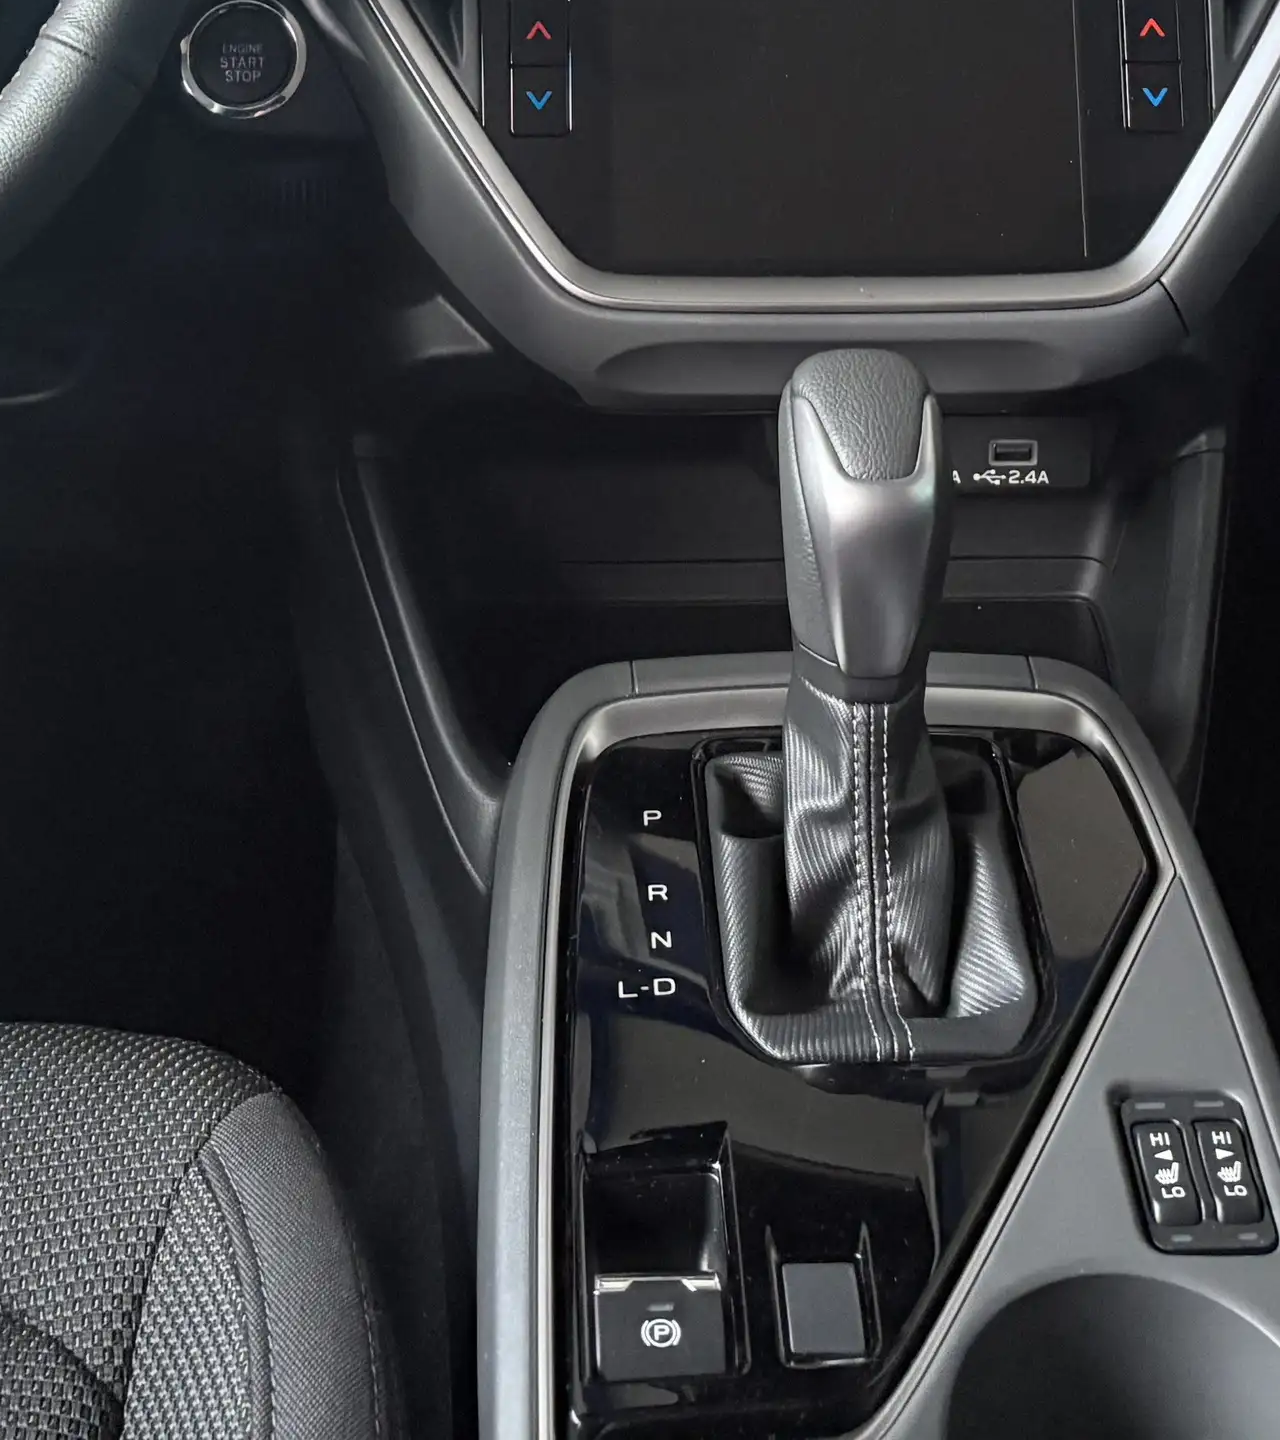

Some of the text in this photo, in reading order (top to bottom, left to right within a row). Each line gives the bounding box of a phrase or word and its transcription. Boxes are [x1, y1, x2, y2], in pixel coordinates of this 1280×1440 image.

[220, 56, 264, 69] START
[225, 70, 261, 83] STOP
[1008, 470, 1049, 484] 2.4A
[643, 810, 662, 826] P
[648, 884, 668, 901] R
[651, 931, 672, 949] N
[1149, 1132, 1170, 1146] HI
[1211, 1131, 1232, 1144] HI
[1161, 1186, 1186, 1198] LO
[1224, 1185, 1248, 1196] LO
